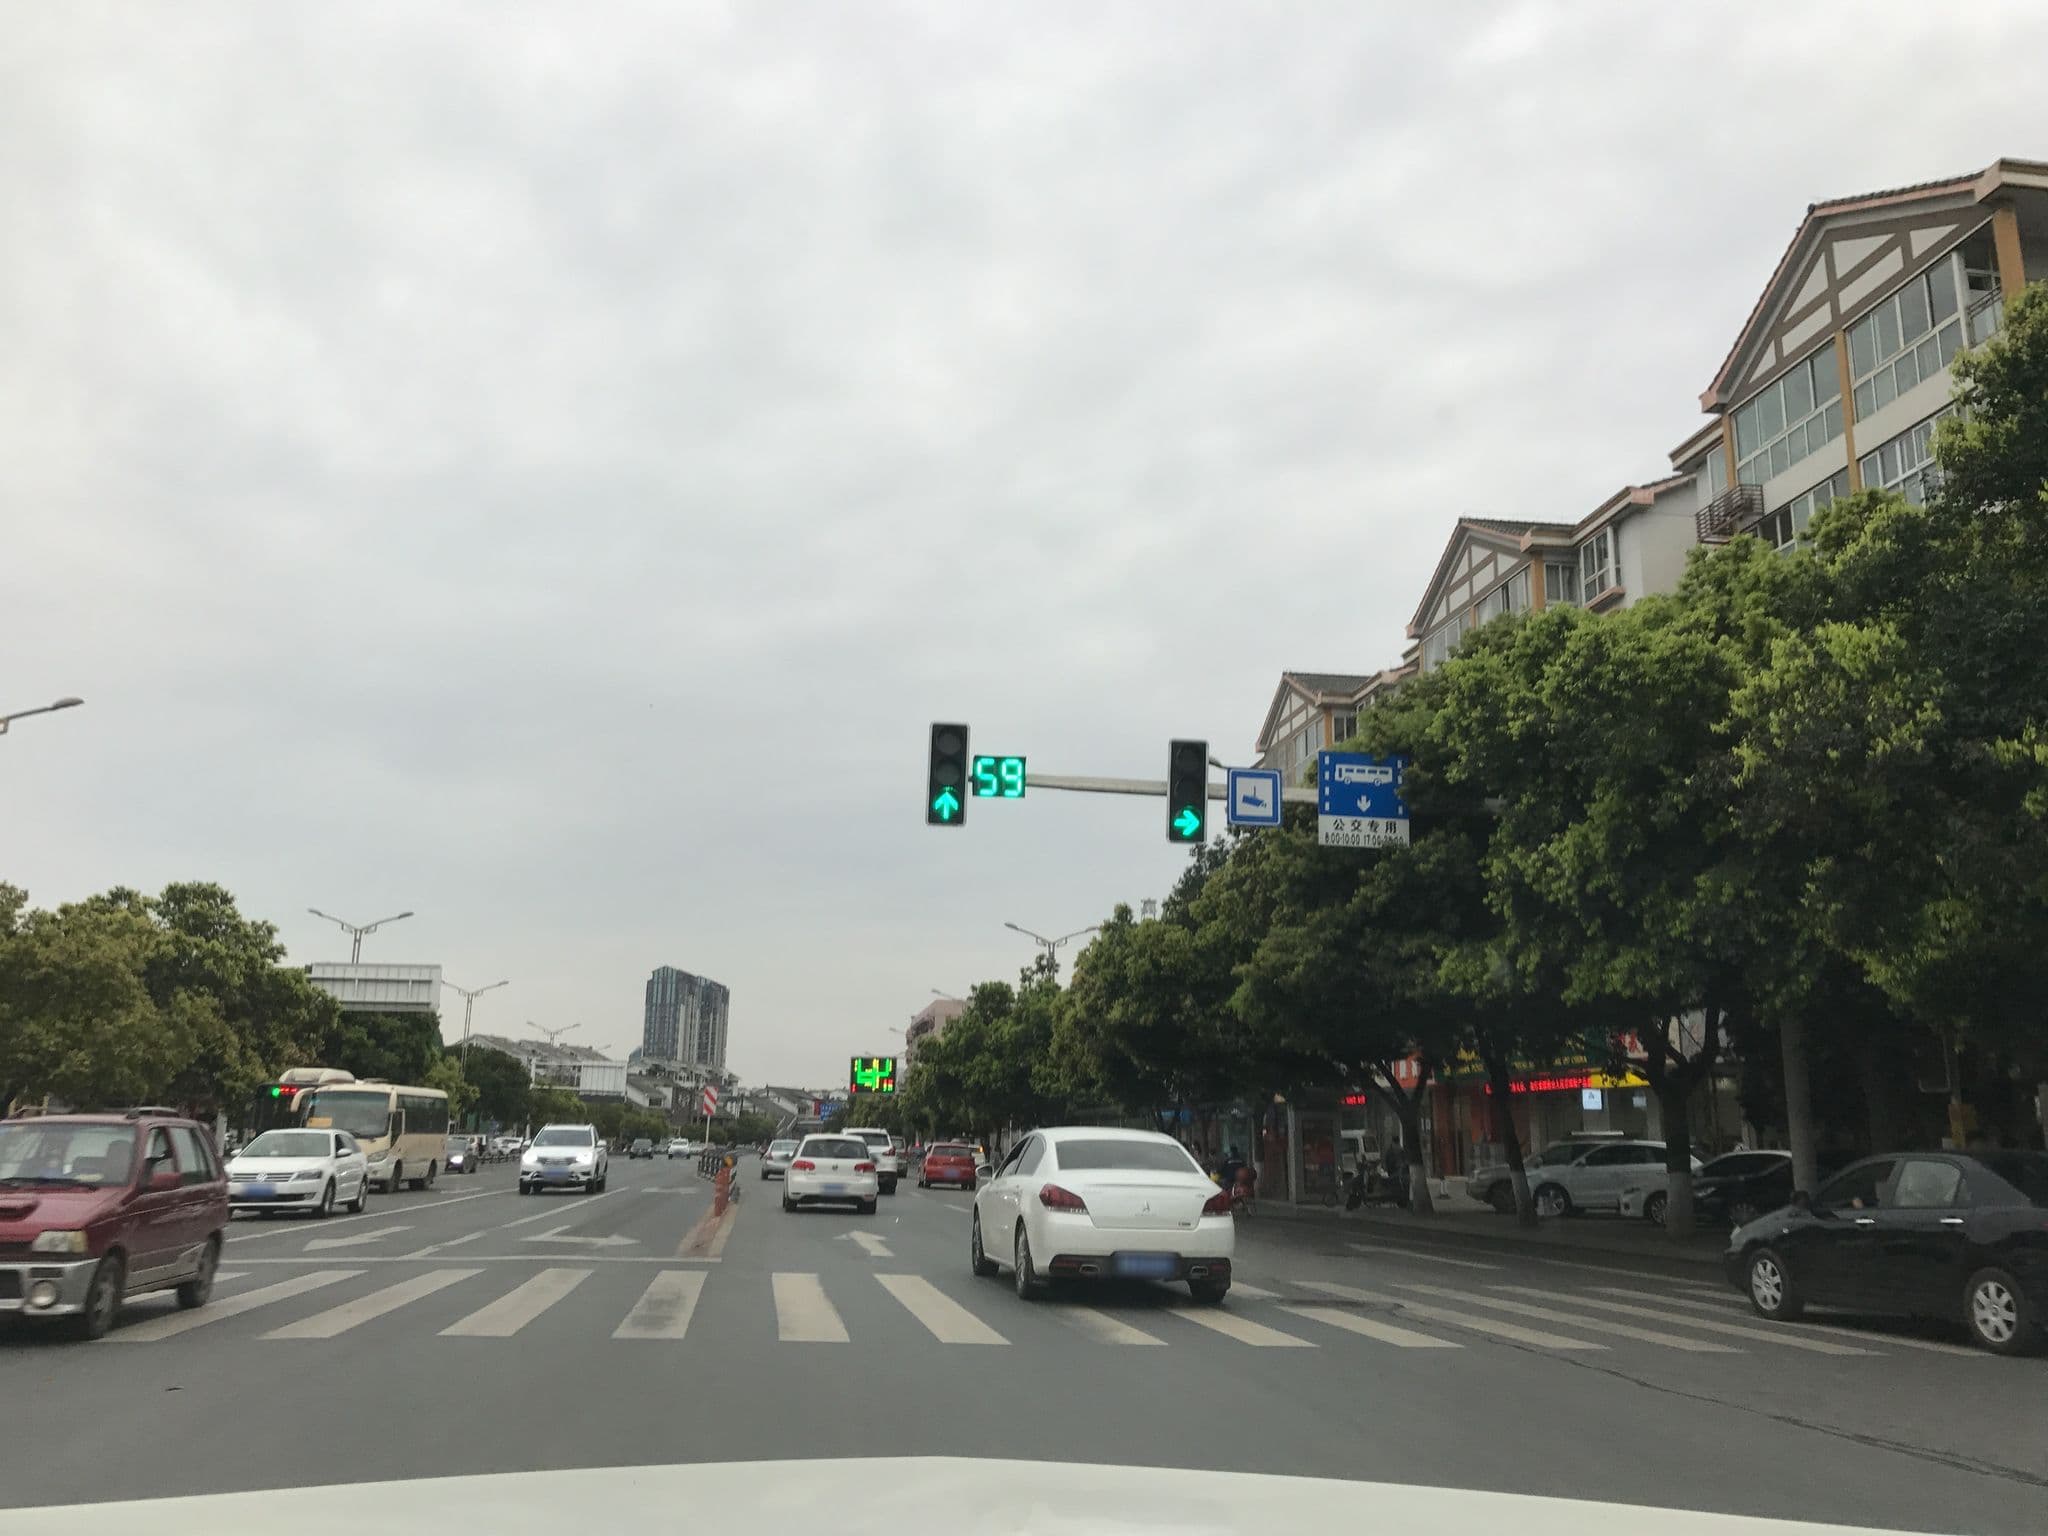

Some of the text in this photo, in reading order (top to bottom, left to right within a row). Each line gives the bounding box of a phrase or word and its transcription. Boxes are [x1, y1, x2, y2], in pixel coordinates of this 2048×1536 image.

[977, 758, 1022, 797] 59
[1333, 818, 1397, 834] 公交专用
